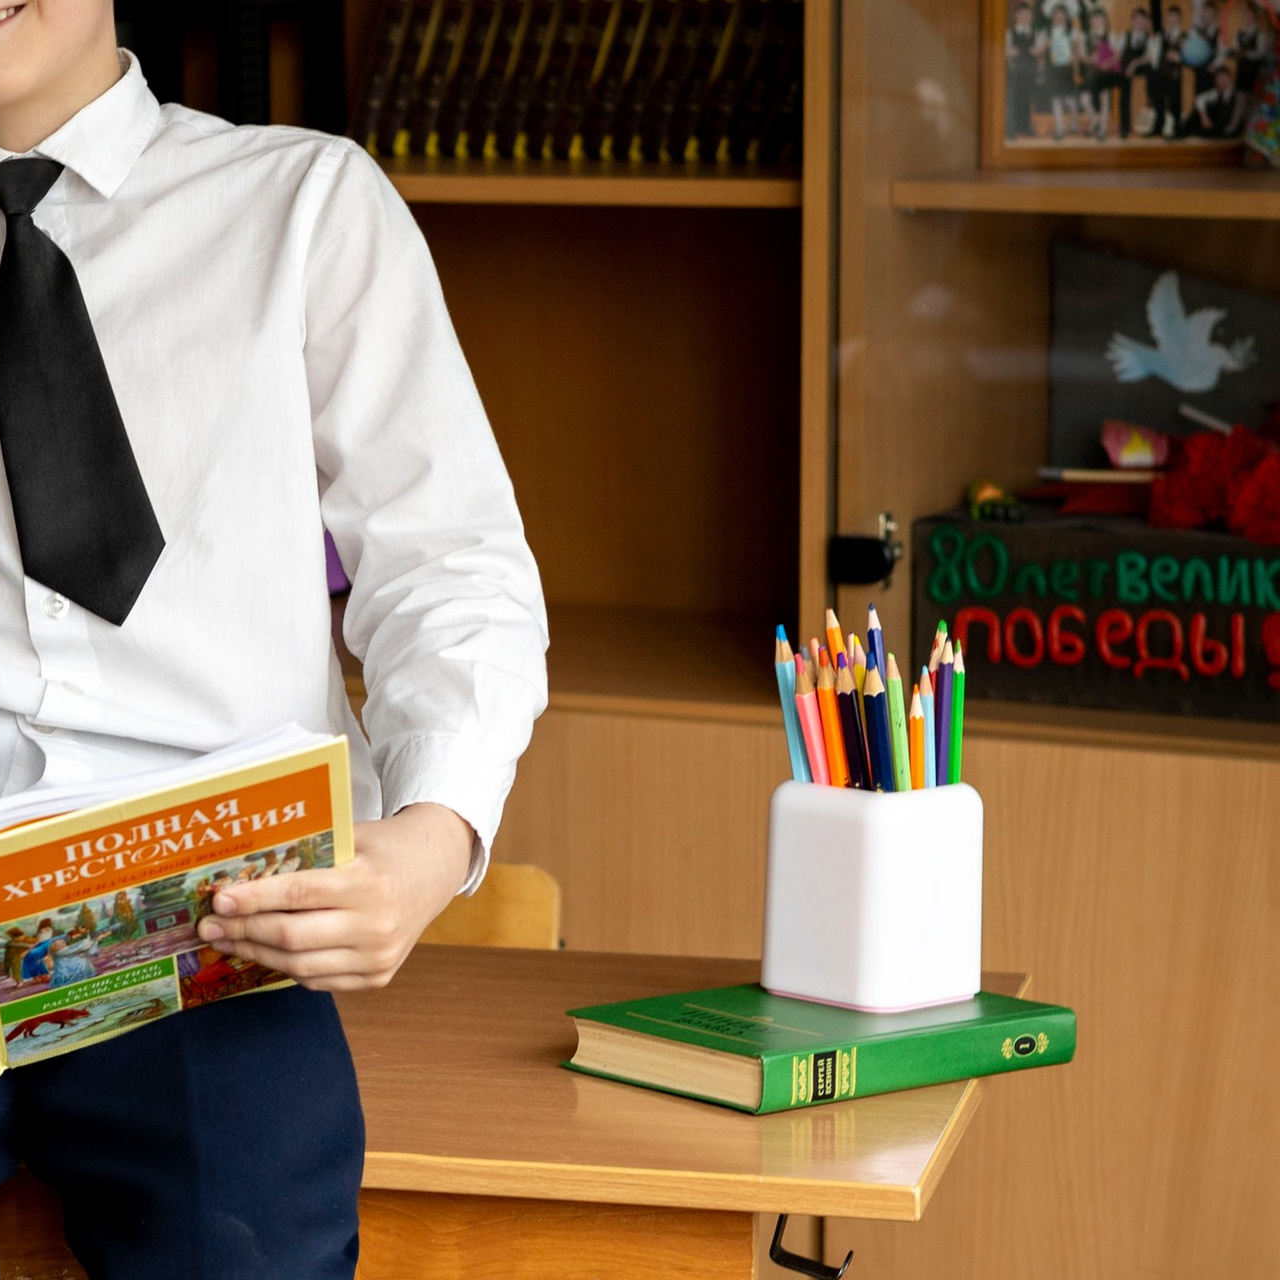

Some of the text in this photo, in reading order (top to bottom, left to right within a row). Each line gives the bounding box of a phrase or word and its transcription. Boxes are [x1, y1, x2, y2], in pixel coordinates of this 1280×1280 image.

[926, 524, 1010, 605] 80
[0, 799, 307, 903] ХРЕСТОМАТИЯ
[64, 797, 240, 864] ПОЛНАЯ
[41, 969, 162, 1011] РАССКАЗЫ, СКАЗКИ
[67, 964, 162, 997] БАСНИ, СТИХИ,
[817, 1058, 826, 1097] СЕРГЕЙ
